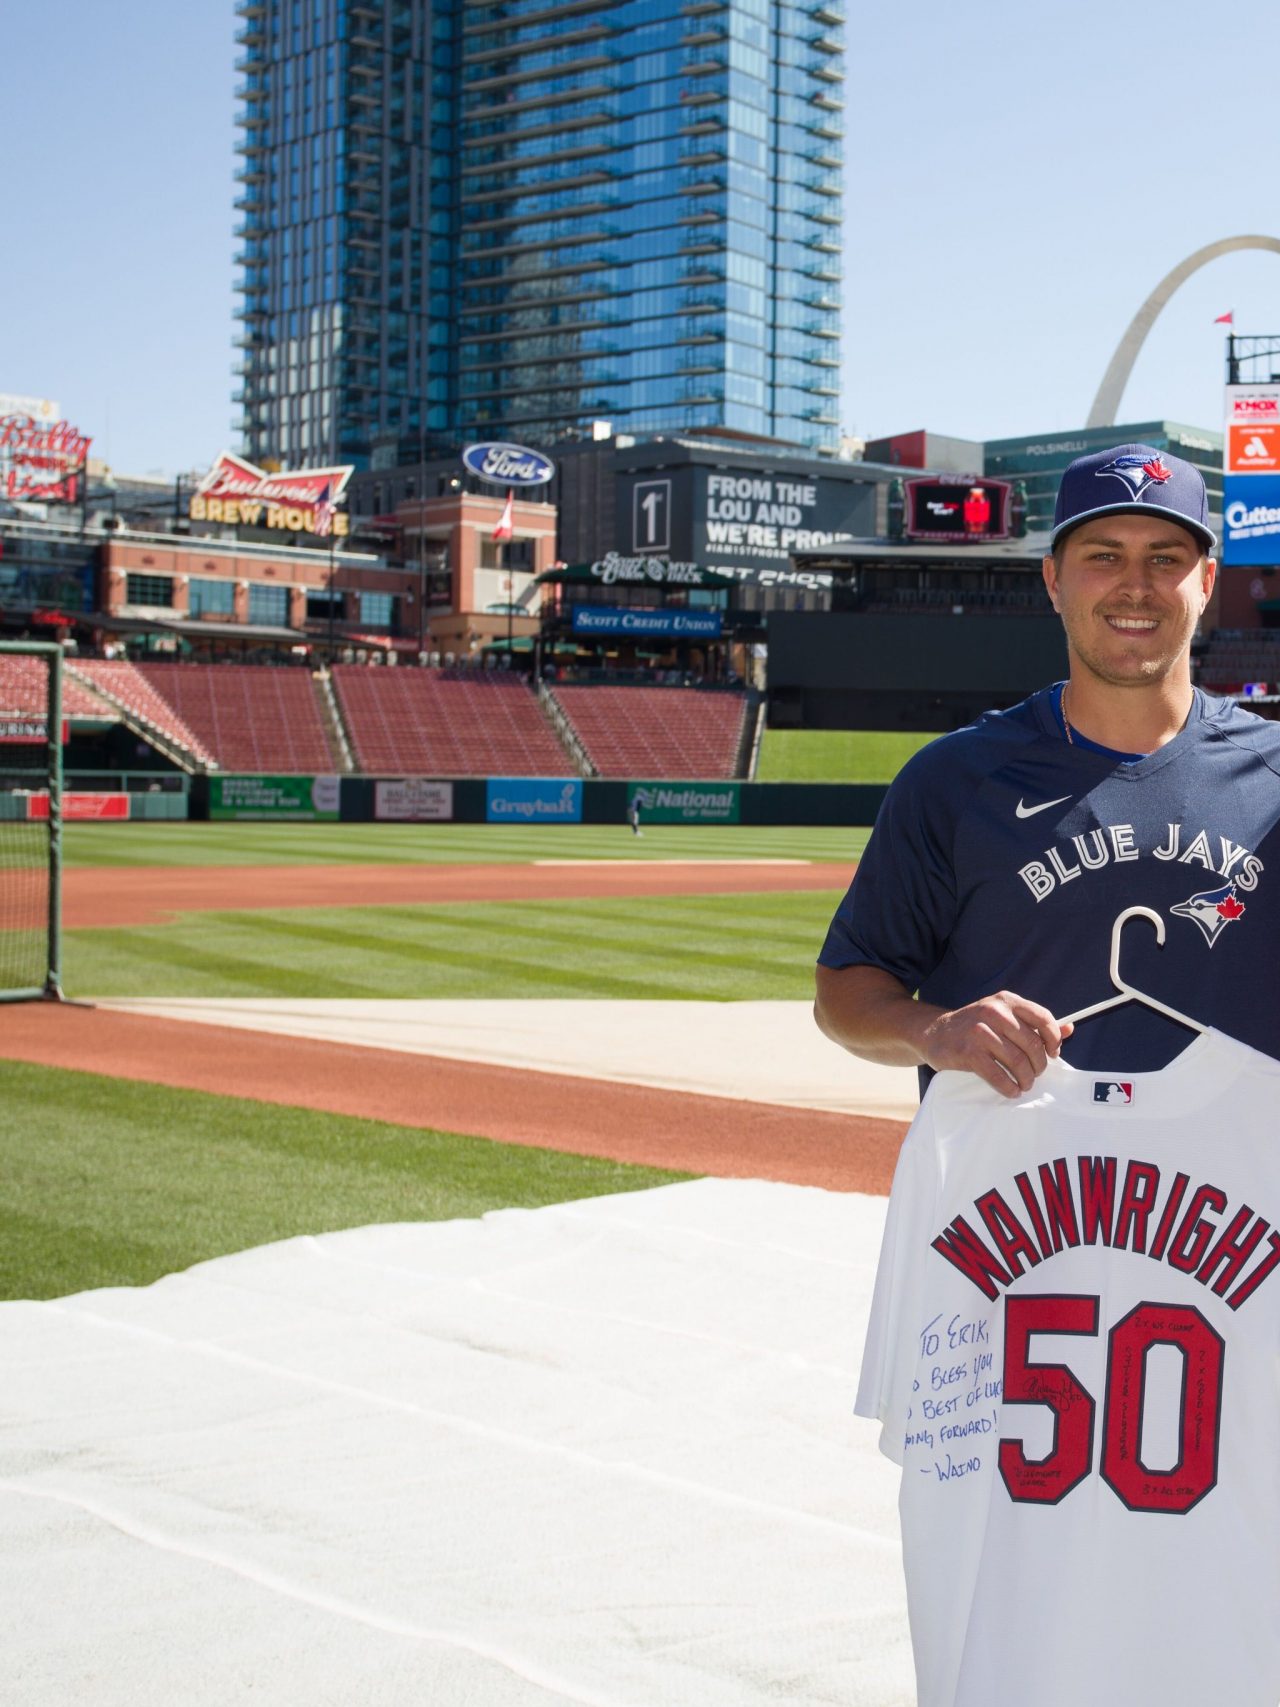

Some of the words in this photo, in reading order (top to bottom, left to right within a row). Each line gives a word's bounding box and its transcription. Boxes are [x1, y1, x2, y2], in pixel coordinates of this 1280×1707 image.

[1234, 400, 1278, 411] KMOX
[1026, 440, 1088, 456] POLSINELLI
[482, 447, 536, 480] Ford
[707, 475, 772, 501] FROM
[776, 482, 816, 506] THE
[190, 495, 262, 526] BREW
[267, 507, 350, 537] HOUE
[707, 498, 751, 522] LOU
[755, 503, 802, 526] AND
[706, 521, 778, 548] WE'RE
[0, 723, 47, 736] URINA
[657, 790, 734, 808] National
[1017, 823, 1140, 902] BLUE
[1152, 823, 1265, 892] JAYS
[998, 1293, 1226, 1515] 50
